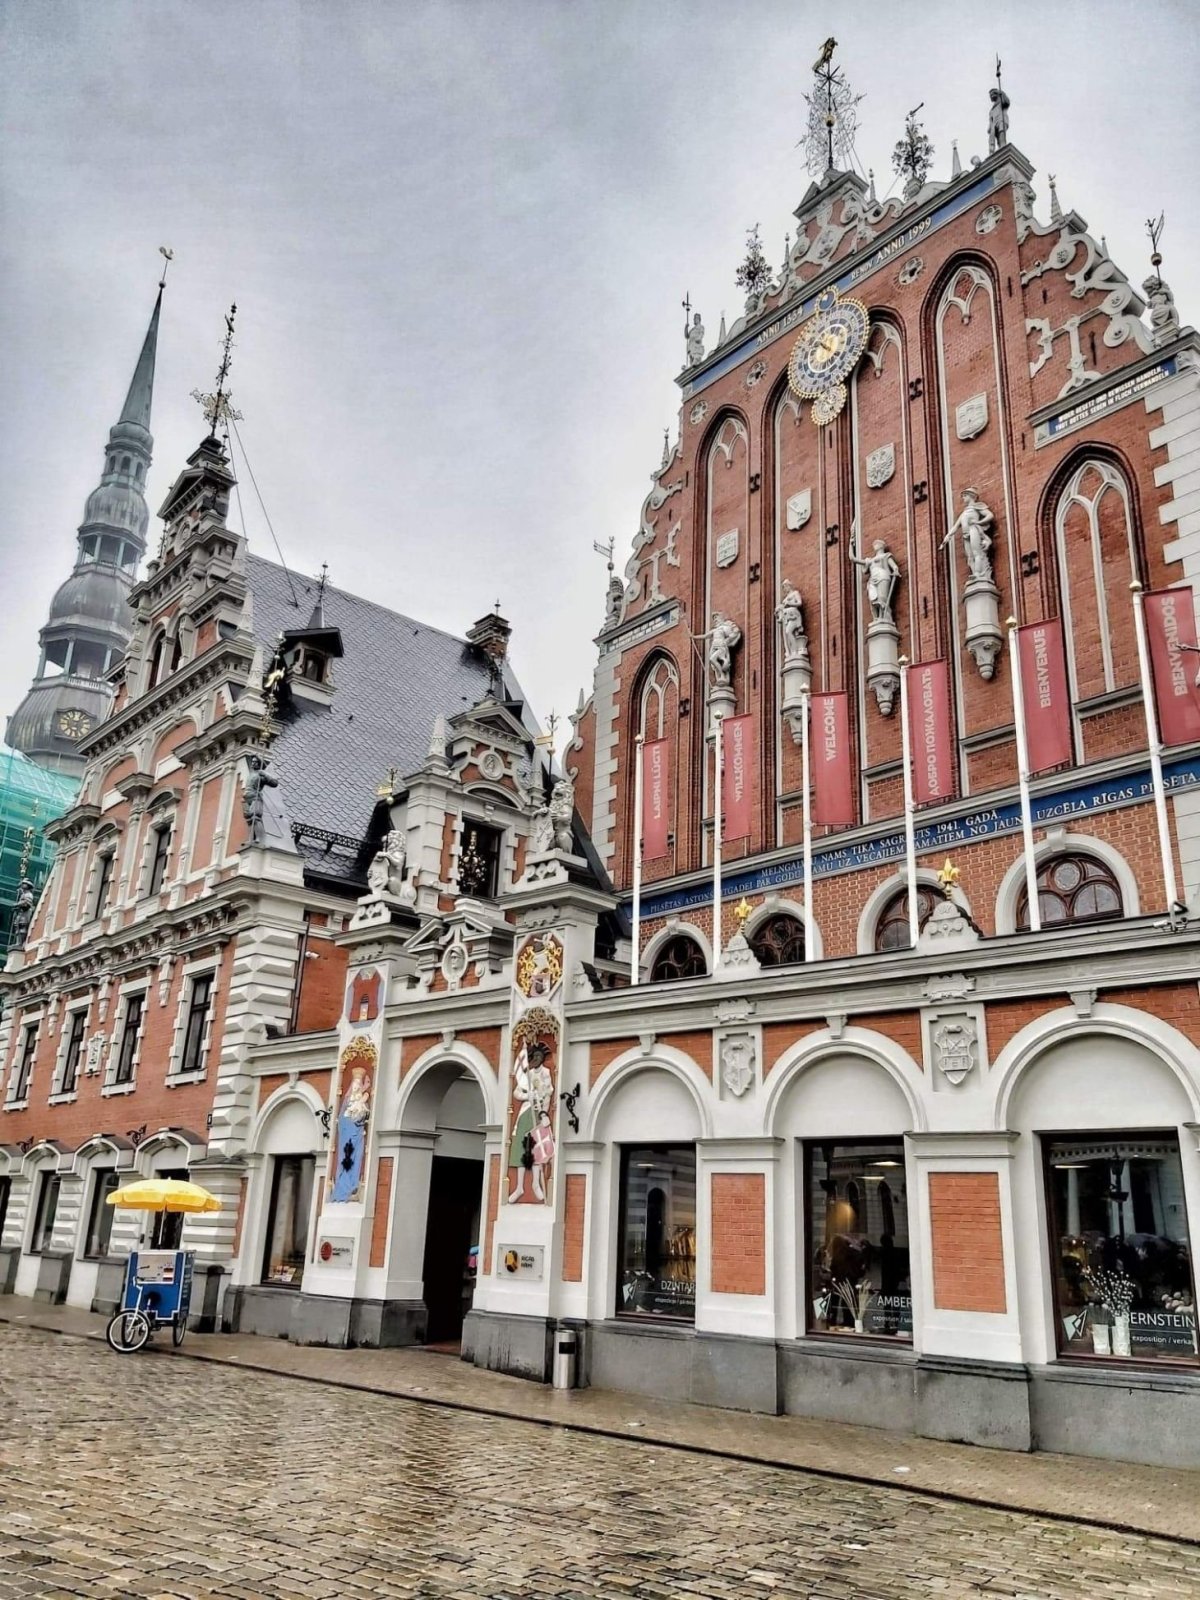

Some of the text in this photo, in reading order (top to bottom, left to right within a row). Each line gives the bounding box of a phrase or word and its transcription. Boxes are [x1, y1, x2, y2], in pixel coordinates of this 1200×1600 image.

[877, 236, 905, 263] ANNO
[908, 217, 931, 240] 1999
[756, 321, 780, 346] ANNO
[1033, 628, 1051, 709] BIENVENUE
[1161, 596, 1188, 697] BIENVENIDOS
[823, 697, 837, 761] WELCOME
[921, 667, 941, 796] ДОБРО ПОЖАЛОВАТЬ
[733, 721, 744, 802] WILLKOMMEN
[653, 781, 661, 819] LAIPNI
[756, 877, 771, 888] PAR
[775, 870, 801, 883] GODU
[812, 862, 833, 875] AMU
[838, 859, 852, 868] UZ
[856, 845, 905, 863] VECAJIEM
[914, 831, 965, 849] AMATIEM
[970, 823, 988, 835] NO
[1036, 799, 1087, 820] UZCĒLA
[1092, 787, 1133, 806] RĪGAS
[821, 849, 847, 863] NAMS
[851, 842, 875, 855] TIKA
[880, 828, 930, 848] SAGRUTS
[936, 820, 961, 834] 1941.
[877, 1295, 912, 1308] AMBER
[1132, 1335, 1167, 1343] exposition
